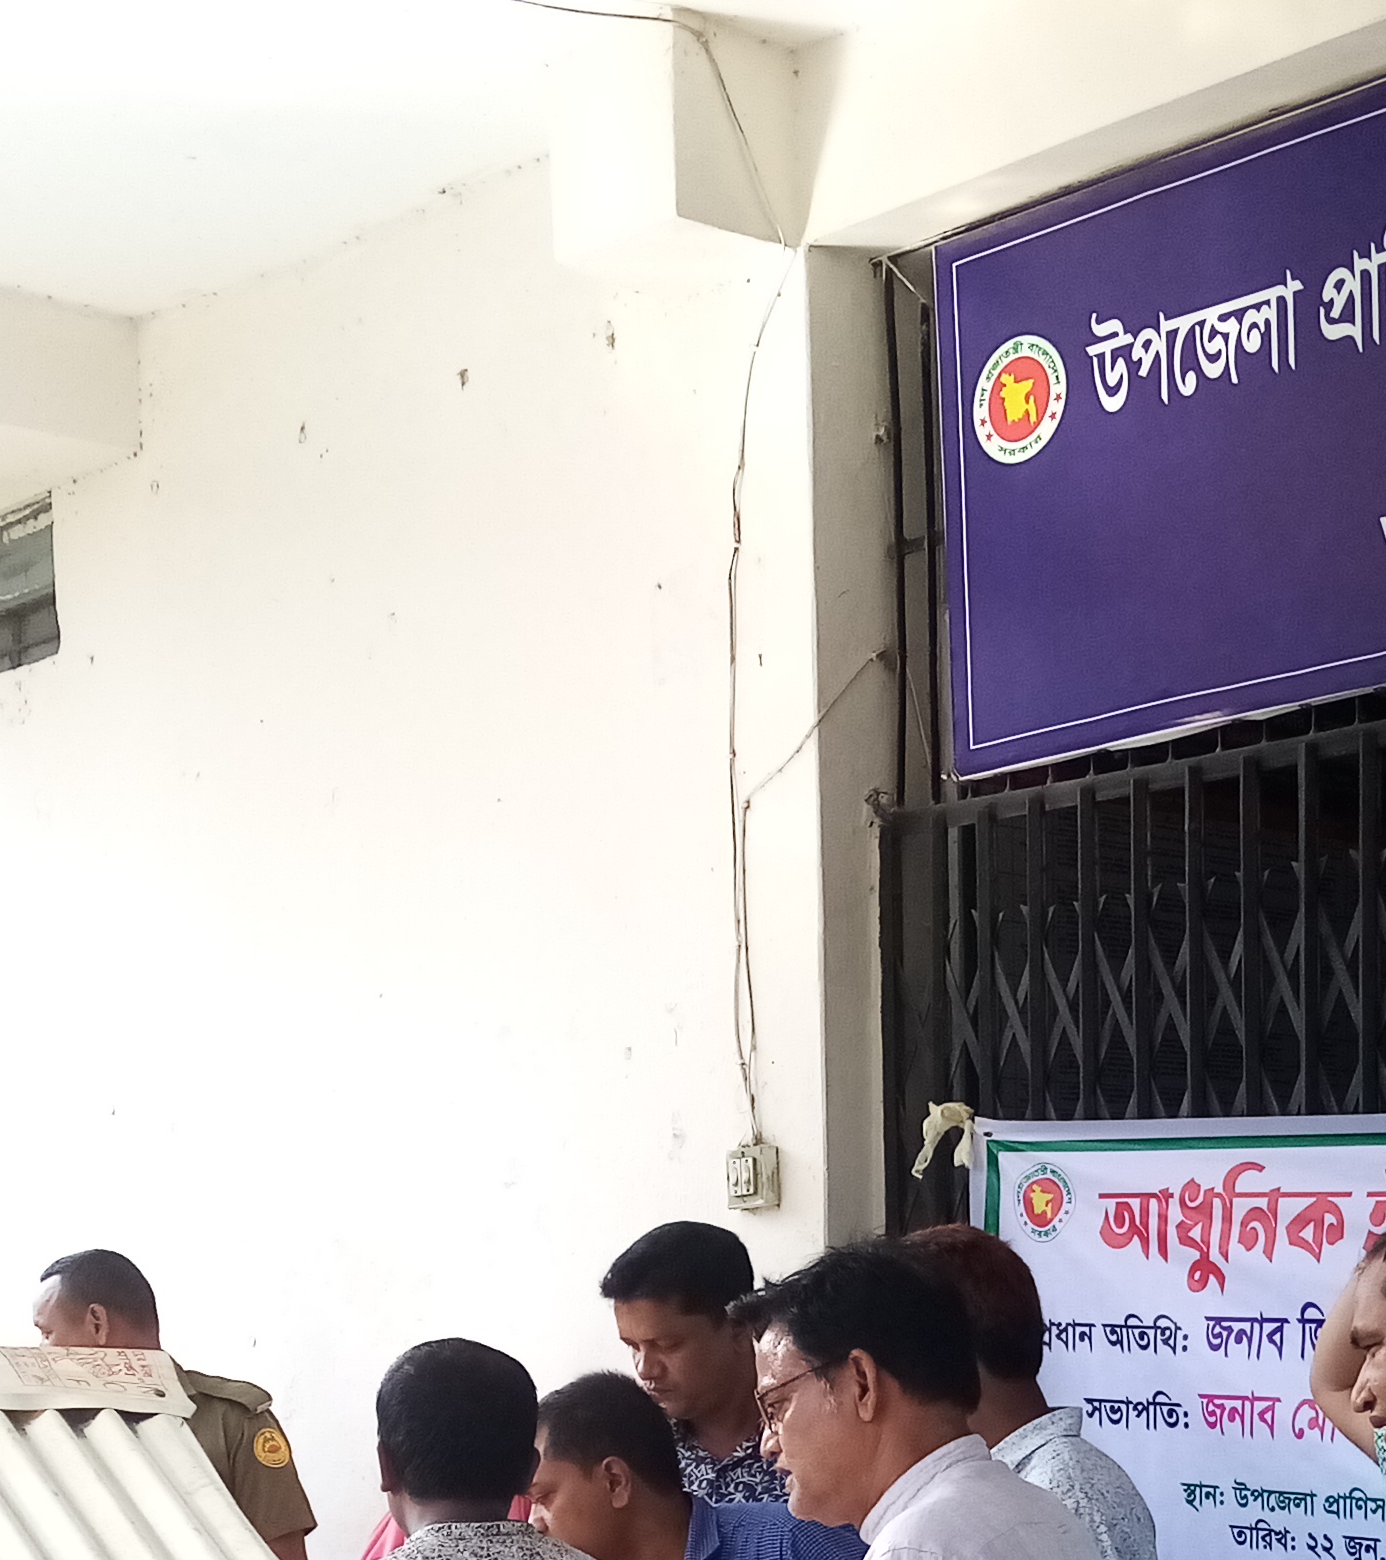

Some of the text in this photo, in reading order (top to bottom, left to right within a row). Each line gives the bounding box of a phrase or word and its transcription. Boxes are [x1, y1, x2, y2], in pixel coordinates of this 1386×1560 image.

[1087, 270, 1303, 412] উপজেলা
[1098, 1161, 1353, 1294] আধুনিক
[1101, 1313, 1189, 1356] অতিথি:
[1204, 1310, 1290, 1362] জনাব
[1083, 1389, 1190, 1431] সভাপতি:
[1198, 1390, 1281, 1439] জনাব
[1231, 1479, 1318, 1518] উপজেলা
[1230, 1520, 1297, 1552] তারিখ:
[1306, 1531, 1336, 1560] ২২
